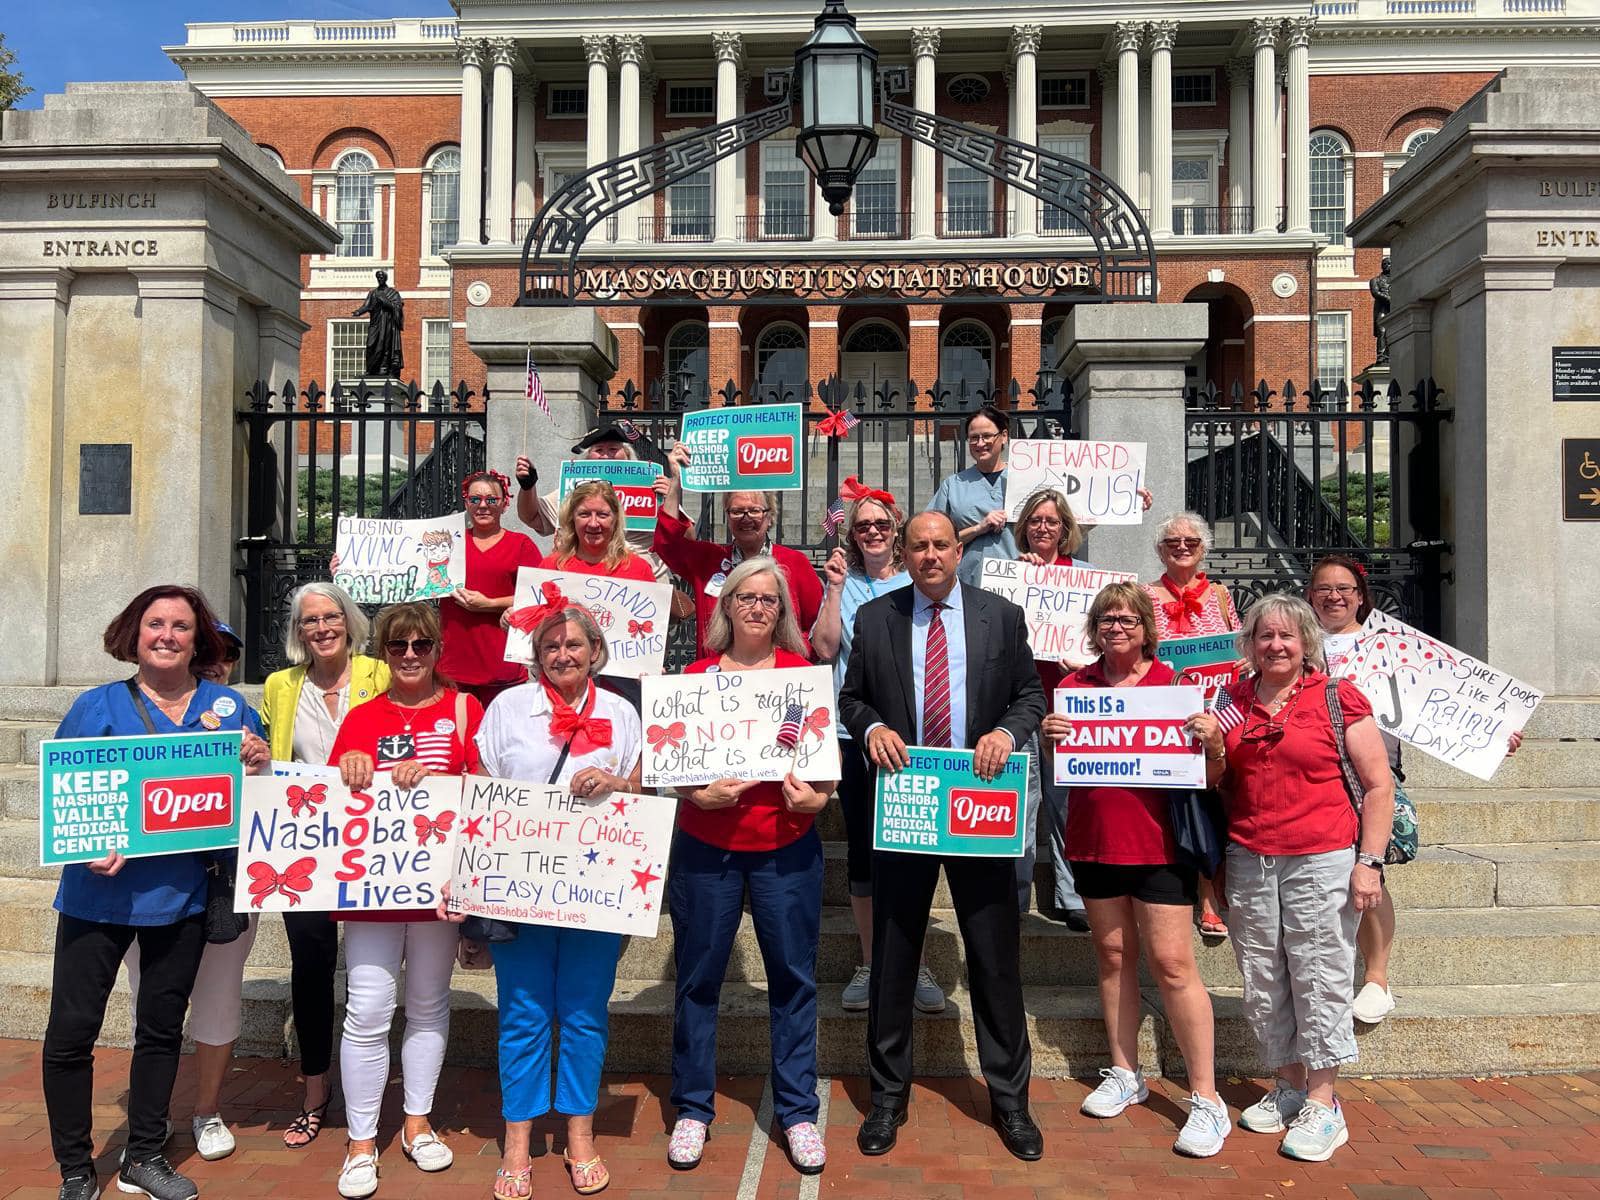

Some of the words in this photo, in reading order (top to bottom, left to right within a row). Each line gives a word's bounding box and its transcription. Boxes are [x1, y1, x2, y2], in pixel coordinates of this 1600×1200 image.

[1539, 181, 1600, 197] BULF
[47, 193, 156, 209] BULFINCH
[43, 240, 159, 256] ENTRANCE
[583, 268, 858, 291] MASSACHUSETTS
[868, 266, 964, 290] STATE
[976, 265, 1091, 288] HOUSE
[687, 415, 730, 427] PROTECT
[732, 413, 753, 424] OUR
[755, 411, 797, 423] HEALTH:
[685, 429, 730, 445] KEEP
[740, 442, 790, 469] Open
[1011, 441, 1129, 471] STEWARD
[564, 465, 604, 475] PROTECT
[604, 465, 622, 475] OUR
[686, 465, 730, 474] MEDICAL
[686, 474, 731, 486] CENTER
[1088, 468, 1141, 516] US!
[339, 519, 403, 536] CLOSING
[340, 535, 412, 567] NVMC
[985, 560, 1017, 576] OUR
[584, 577, 657, 619] STAND
[1025, 587, 1095, 614] PROFI
[1035, 611, 1052, 621] BY
[608, 634, 664, 660] TIENTS
[1029, 622, 1074, 653] YING
[1175, 644, 1197, 656] OUR
[716, 674, 742, 692] DO
[1453, 657, 1500, 685] SURE
[1498, 678, 1540, 709] LOOKS
[720, 695, 740, 712] is
[755, 682, 814, 723] right
[1065, 696, 1095, 713] This
[1099, 696, 1112, 713] IS
[1115, 699, 1125, 713] a
[1494, 701, 1506, 714] A
[1421, 688, 1503, 749] Rainy
[696, 719, 758, 745] NOT
[1060, 725, 1139, 747] RAINY
[1144, 725, 1195, 747] DAY
[49, 747, 129, 767] PROTECT
[132, 745, 167, 762] OUR
[171, 742, 238, 759] HEALTH:
[725, 747, 746, 766] is
[904, 756, 940, 770] TECT
[943, 758, 970, 772] OUR
[1067, 757, 1141, 776] Governor!
[52, 769, 130, 795] KEEP
[883, 773, 941, 795] KEEP
[52, 791, 129, 809] NASHOBA
[148, 786, 228, 822] Open
[344, 788, 430, 817] Save
[471, 782, 531, 811] MAKE
[544, 790, 587, 814] THE
[883, 792, 939, 806] NASHOBA
[52, 804, 129, 824] VALLEY
[883, 803, 939, 819] VALLEY
[954, 796, 1014, 829] Open
[53, 821, 130, 838] MEDICAL
[493, 810, 571, 842] RIGHT
[578, 816, 648, 852] CHOICE,
[882, 817, 938, 832] MEDICAL
[53, 834, 130, 854] CENTER
[882, 829, 938, 846] CENTER
[334, 848, 431, 882] Save
[458, 846, 510, 875] NOT
[520, 850, 569, 875] THE
[337, 881, 435, 909] Lives
[483, 875, 543, 906] EASY
[552, 880, 625, 910] CHOICE!
